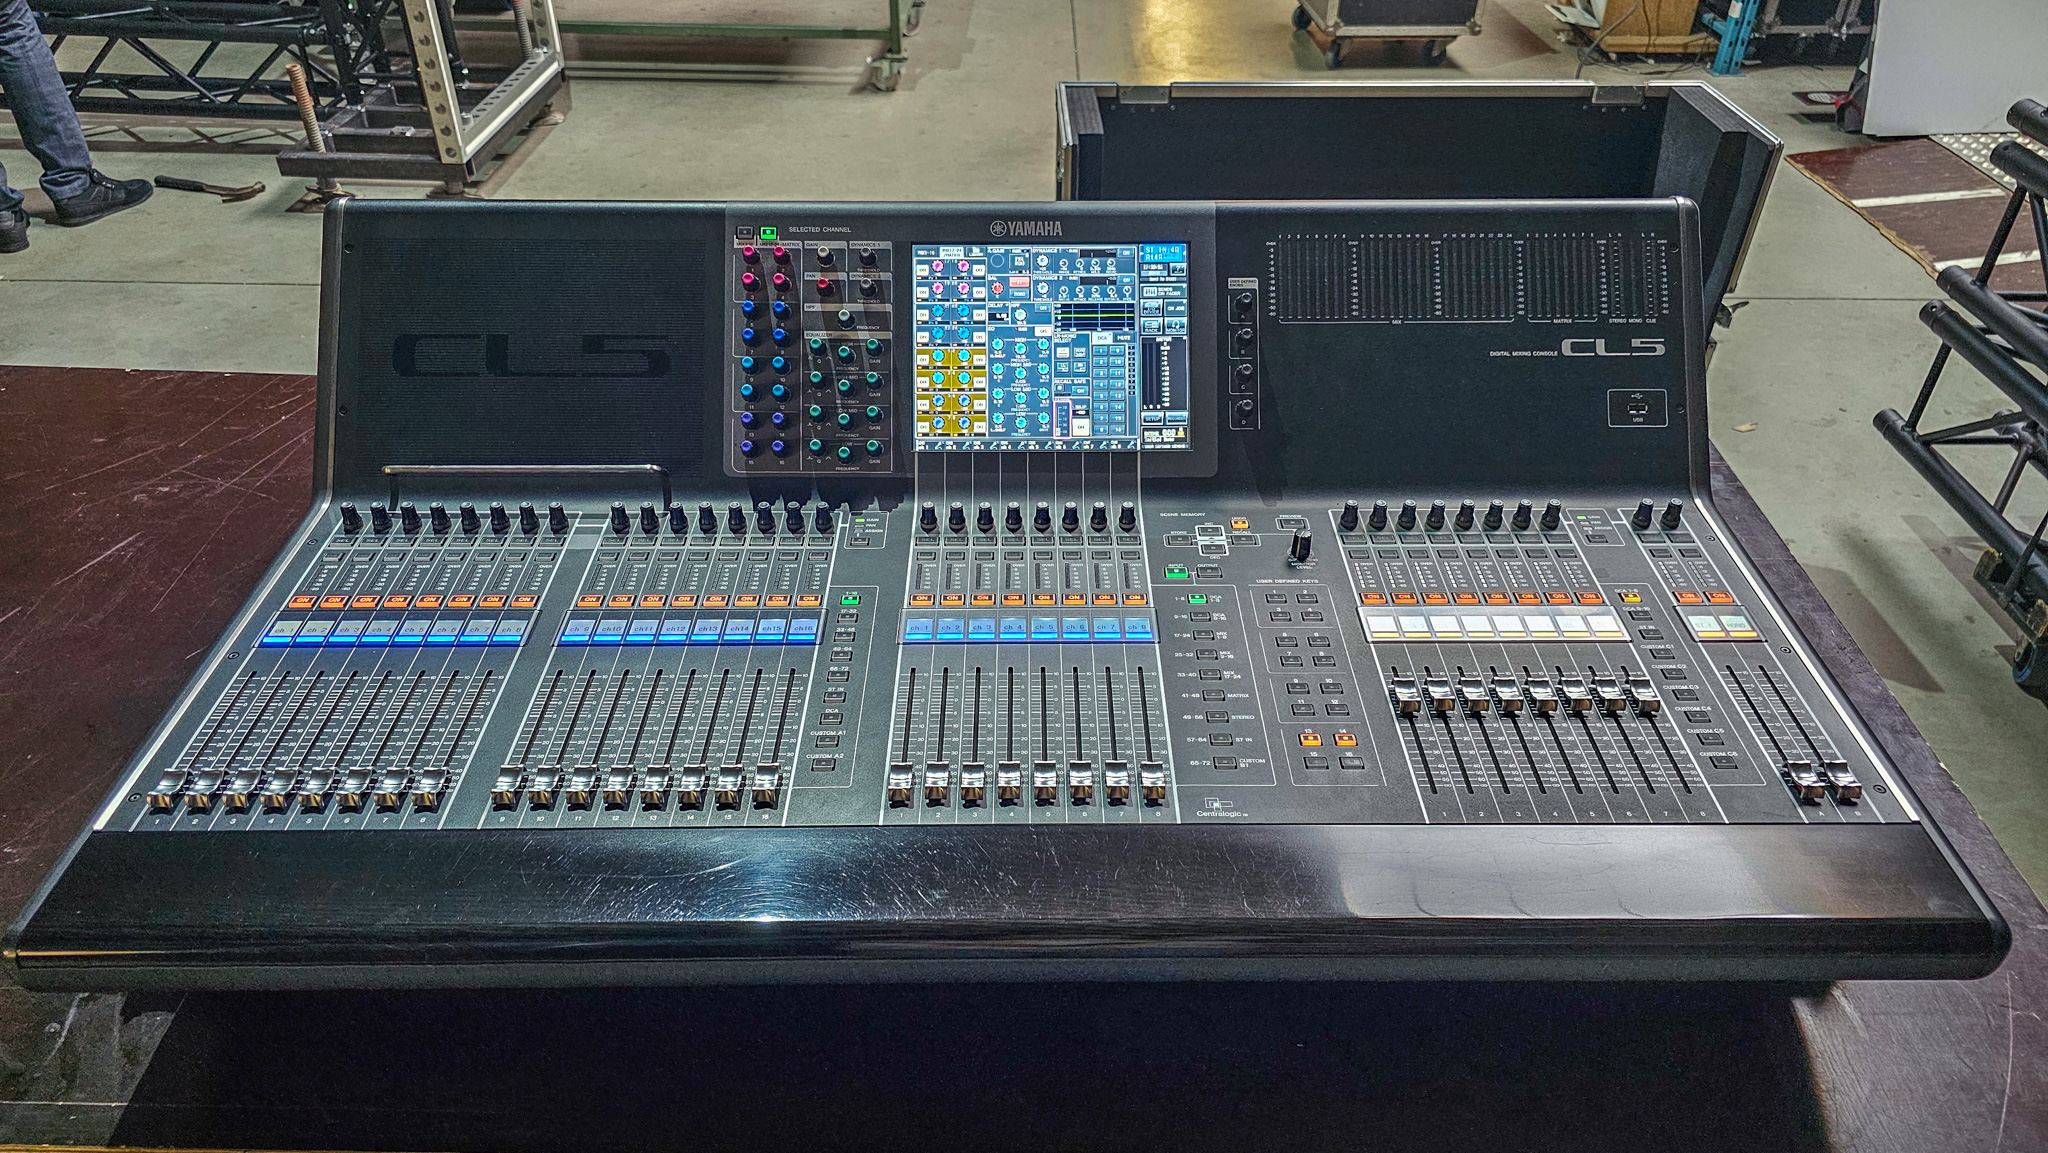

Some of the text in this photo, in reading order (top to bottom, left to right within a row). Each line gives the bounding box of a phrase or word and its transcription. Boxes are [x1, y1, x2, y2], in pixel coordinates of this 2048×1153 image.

[1008, 221, 1062, 236] YAMAHA
[391, 333, 671, 378] CL5
[1561, 338, 1666, 356] CL5
